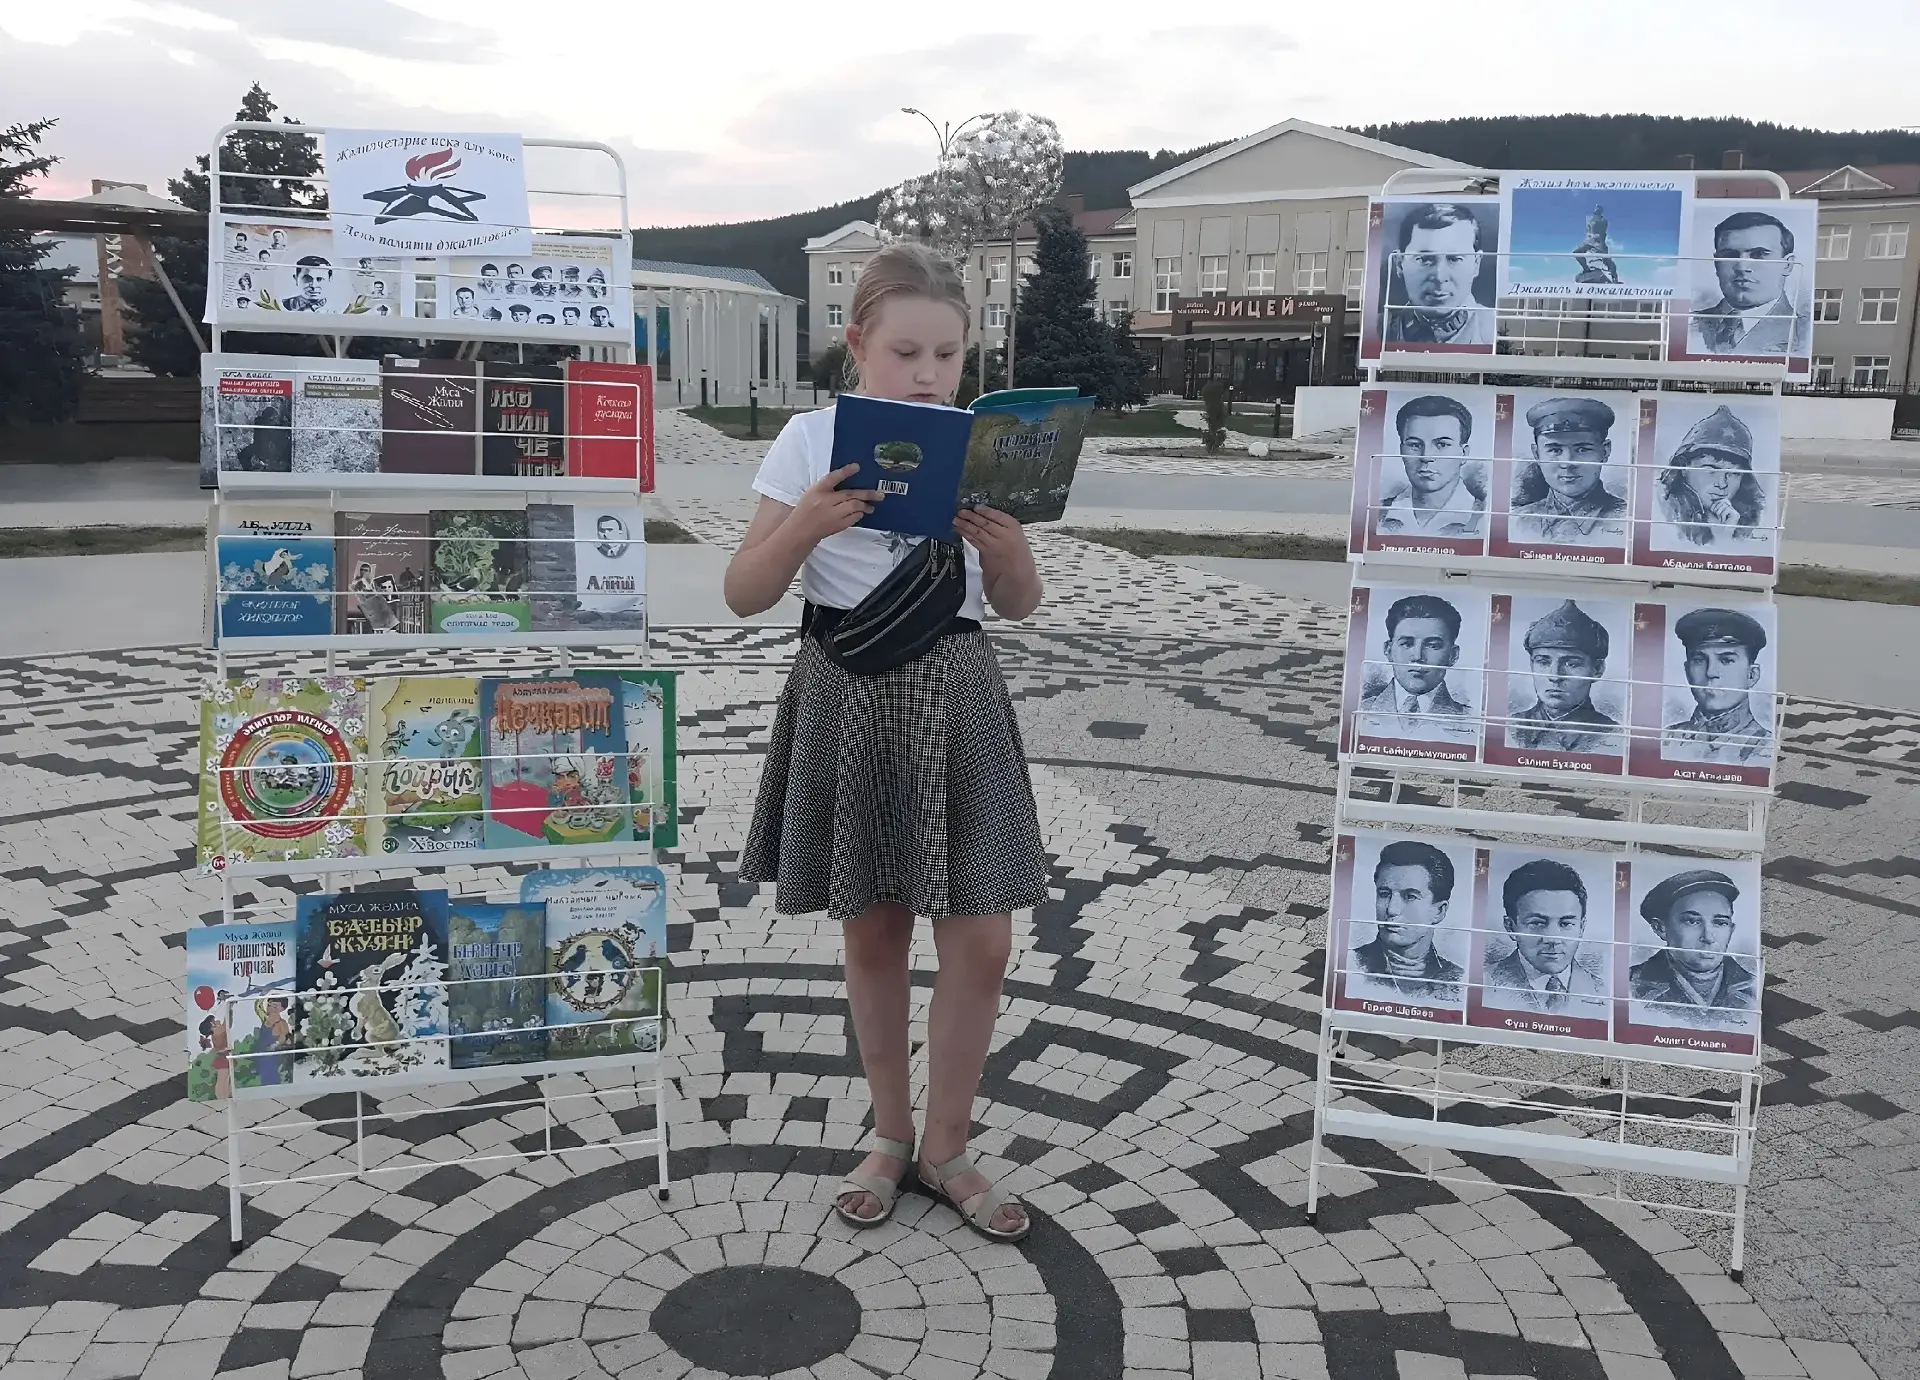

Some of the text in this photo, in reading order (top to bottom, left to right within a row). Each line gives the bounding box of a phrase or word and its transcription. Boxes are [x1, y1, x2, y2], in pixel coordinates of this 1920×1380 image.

[379, 236, 433, 250] памяти
[1508, 283, 1571, 295] Джалиль
[1575, 286, 1583, 294] и
[1213, 297, 1294, 318] ЛИЦЕЙ
[434, 385, 460, 398] Муса
[1517, 756, 1592, 771] Салим Бухаров
[408, 836, 477, 852] Хвосты
[329, 903, 365, 914] МУСА
[326, 915, 423, 937] БАТЫР
[225, 932, 249, 943] Муса
[334, 935, 414, 954] КУЯН
[218, 941, 286, 962] Парашютсыз
[233, 959, 275, 978] курчак
[1362, 1001, 1393, 1013] Гариф
[1504, 1018, 1572, 1033] Фуат Булатов
